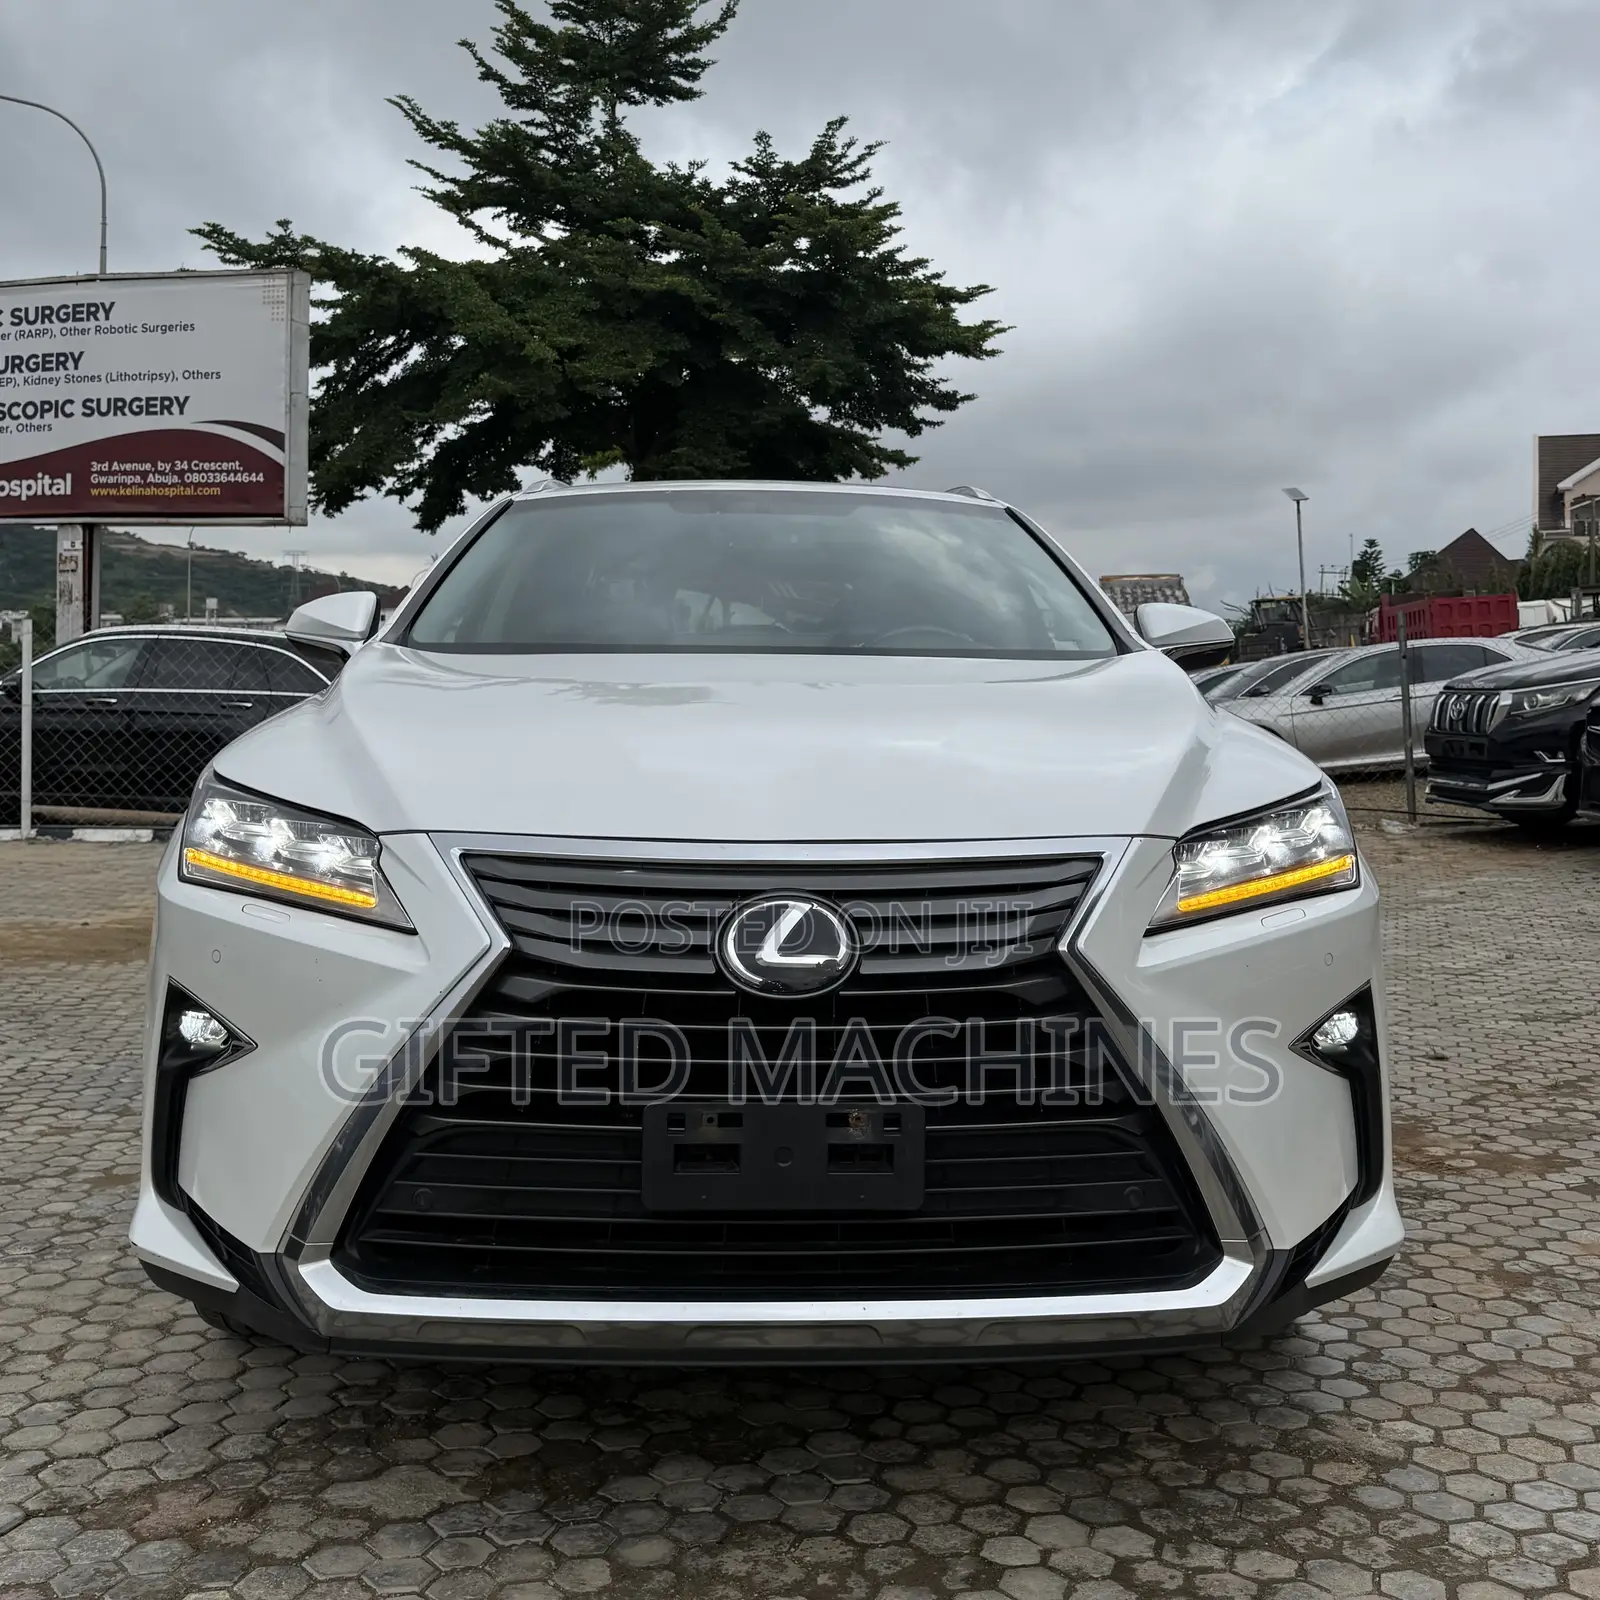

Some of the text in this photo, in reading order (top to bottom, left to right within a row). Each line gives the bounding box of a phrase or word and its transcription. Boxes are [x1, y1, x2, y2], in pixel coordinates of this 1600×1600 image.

[10, 301, 116, 327] SURGERY
[14, 328, 56, 341] (RARP),
[60, 325, 91, 337] Other
[94, 323, 138, 335] Robotic
[141, 321, 195, 334] Surgeries
[23, 375, 61, 387] Kidney
[64, 373, 102, 384] Stones
[105, 369, 179, 384] (Lithotripsy),
[182, 369, 221, 381] Others
[81, 396, 191, 417] SURGERY
[16, 422, 52, 433] Others
[90, 460, 243, 473] 3rd Avenue, by 34 Crescent,
[0, 472, 72, 501] ospital
[90, 472, 264, 485] Gwarinpa, Abuja. 08033644644
[90, 485, 221, 497] www.kelinahospital.com
